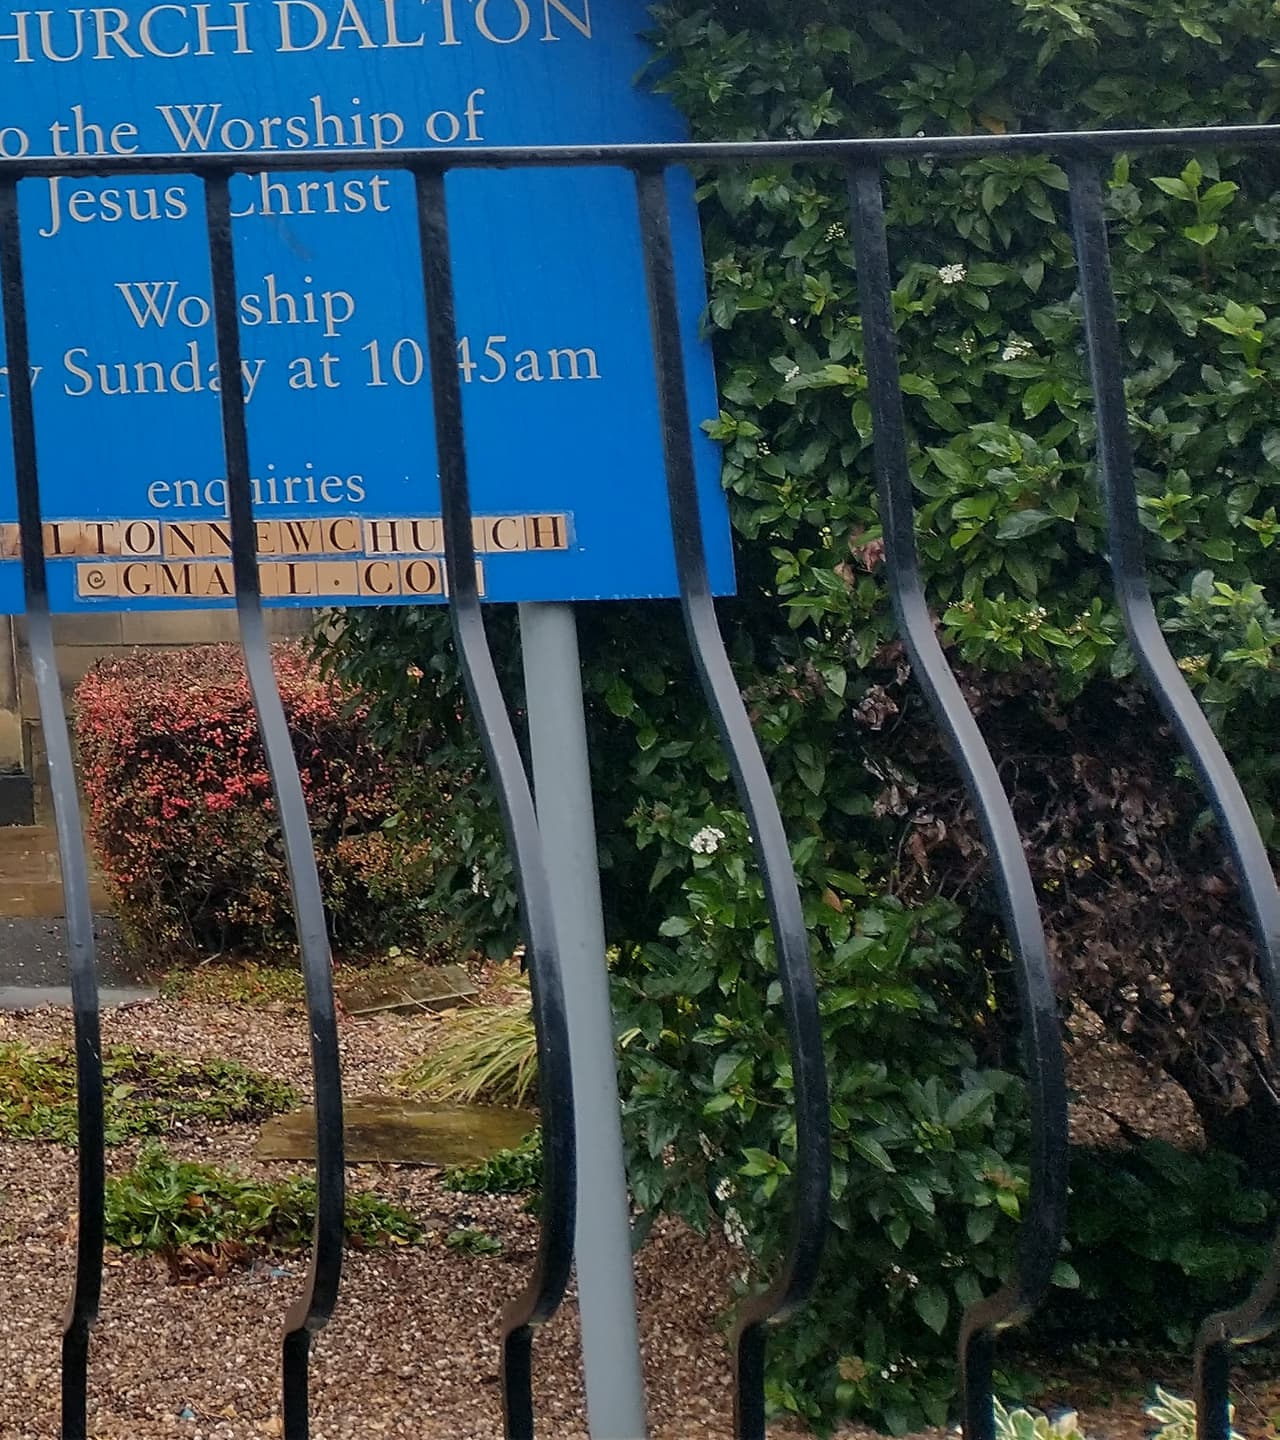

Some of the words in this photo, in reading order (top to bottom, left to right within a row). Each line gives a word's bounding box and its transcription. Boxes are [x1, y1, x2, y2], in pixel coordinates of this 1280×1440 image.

[50, 104, 139, 157] the
[155, 95, 405, 152] Worship
[425, 88, 486, 143] of
[38, 173, 189, 238] Jesus
[115, 273, 356, 337] Woship
[288, 351, 341, 389] at
[361, 335, 602, 388] 1045am
[87, 560, 483, 596] @GMAL.CO
